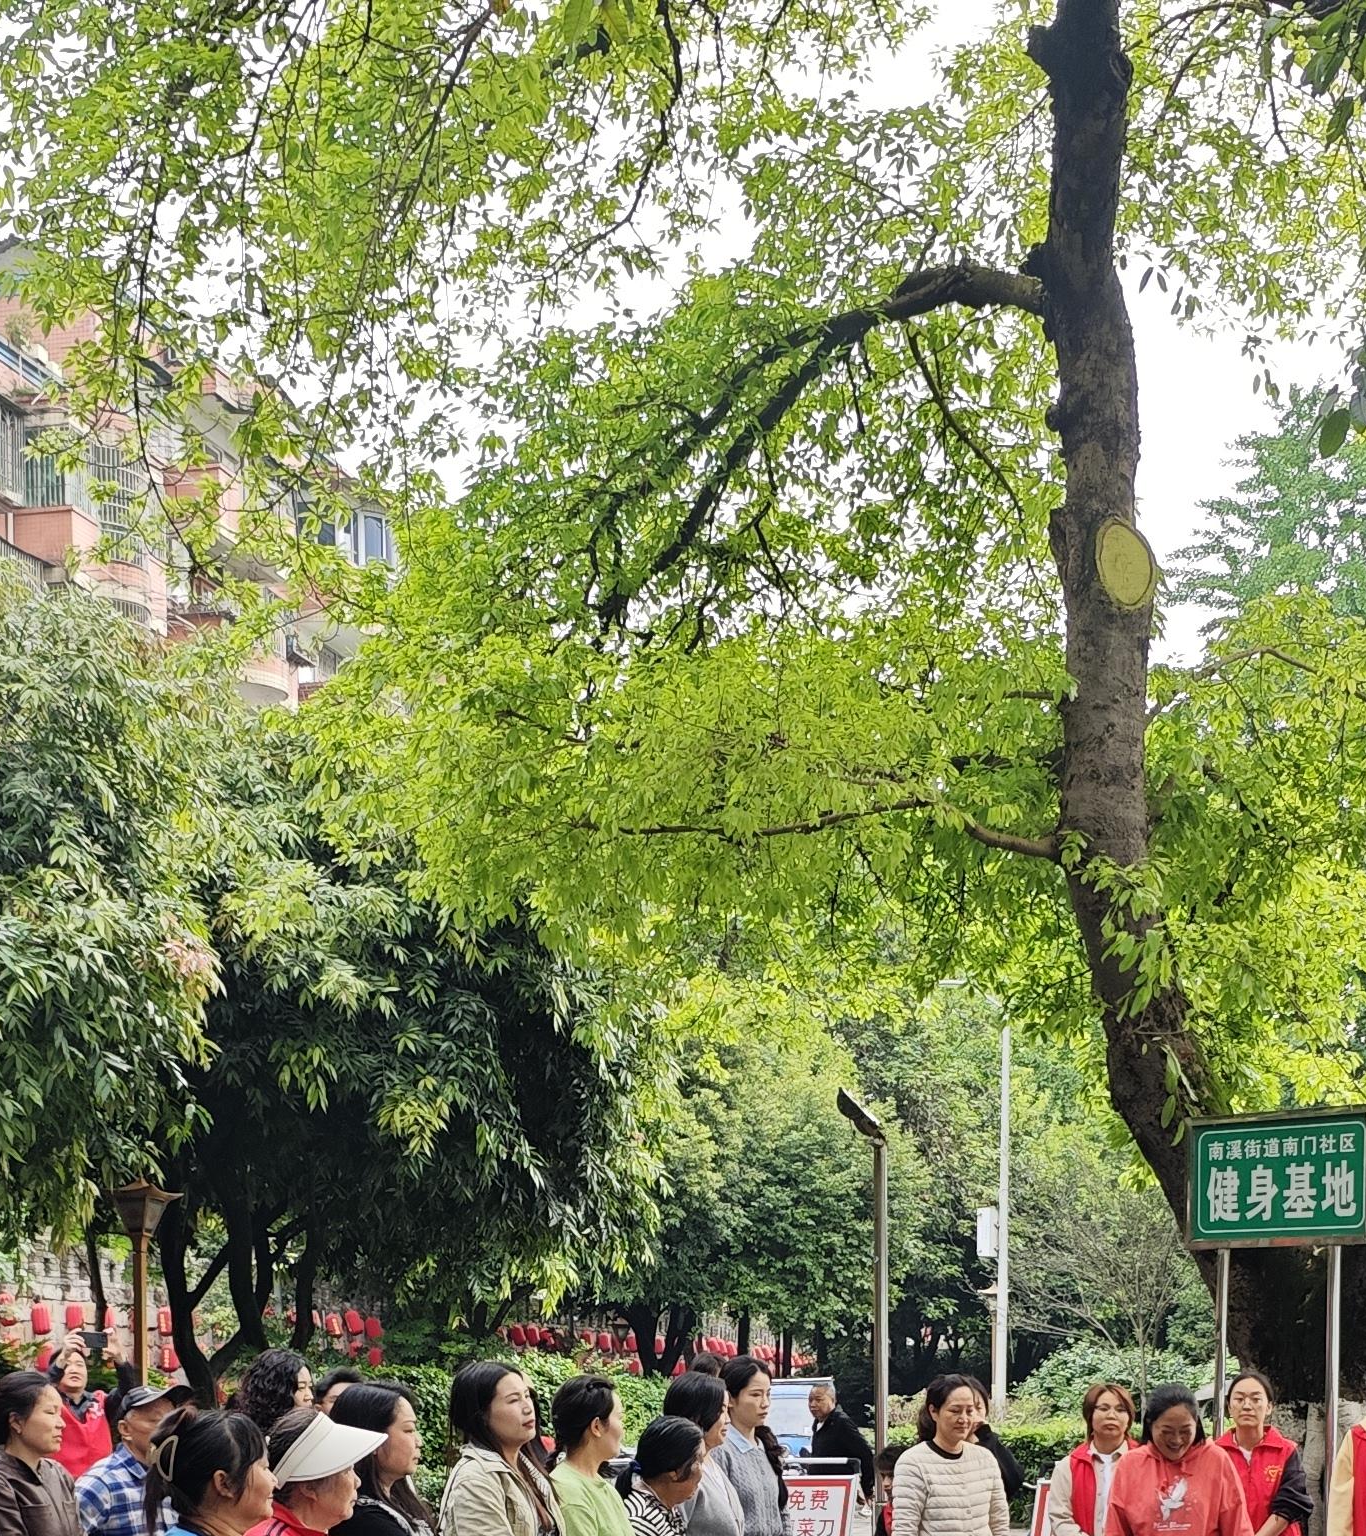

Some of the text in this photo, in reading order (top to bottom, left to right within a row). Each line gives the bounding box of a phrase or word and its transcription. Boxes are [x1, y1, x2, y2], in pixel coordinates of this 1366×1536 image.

[1207, 1133, 1356, 1161] 南溪街道南门社区
[1206, 1160, 1357, 1223] 健身基地
[788, 1490, 830, 1511] 免费
